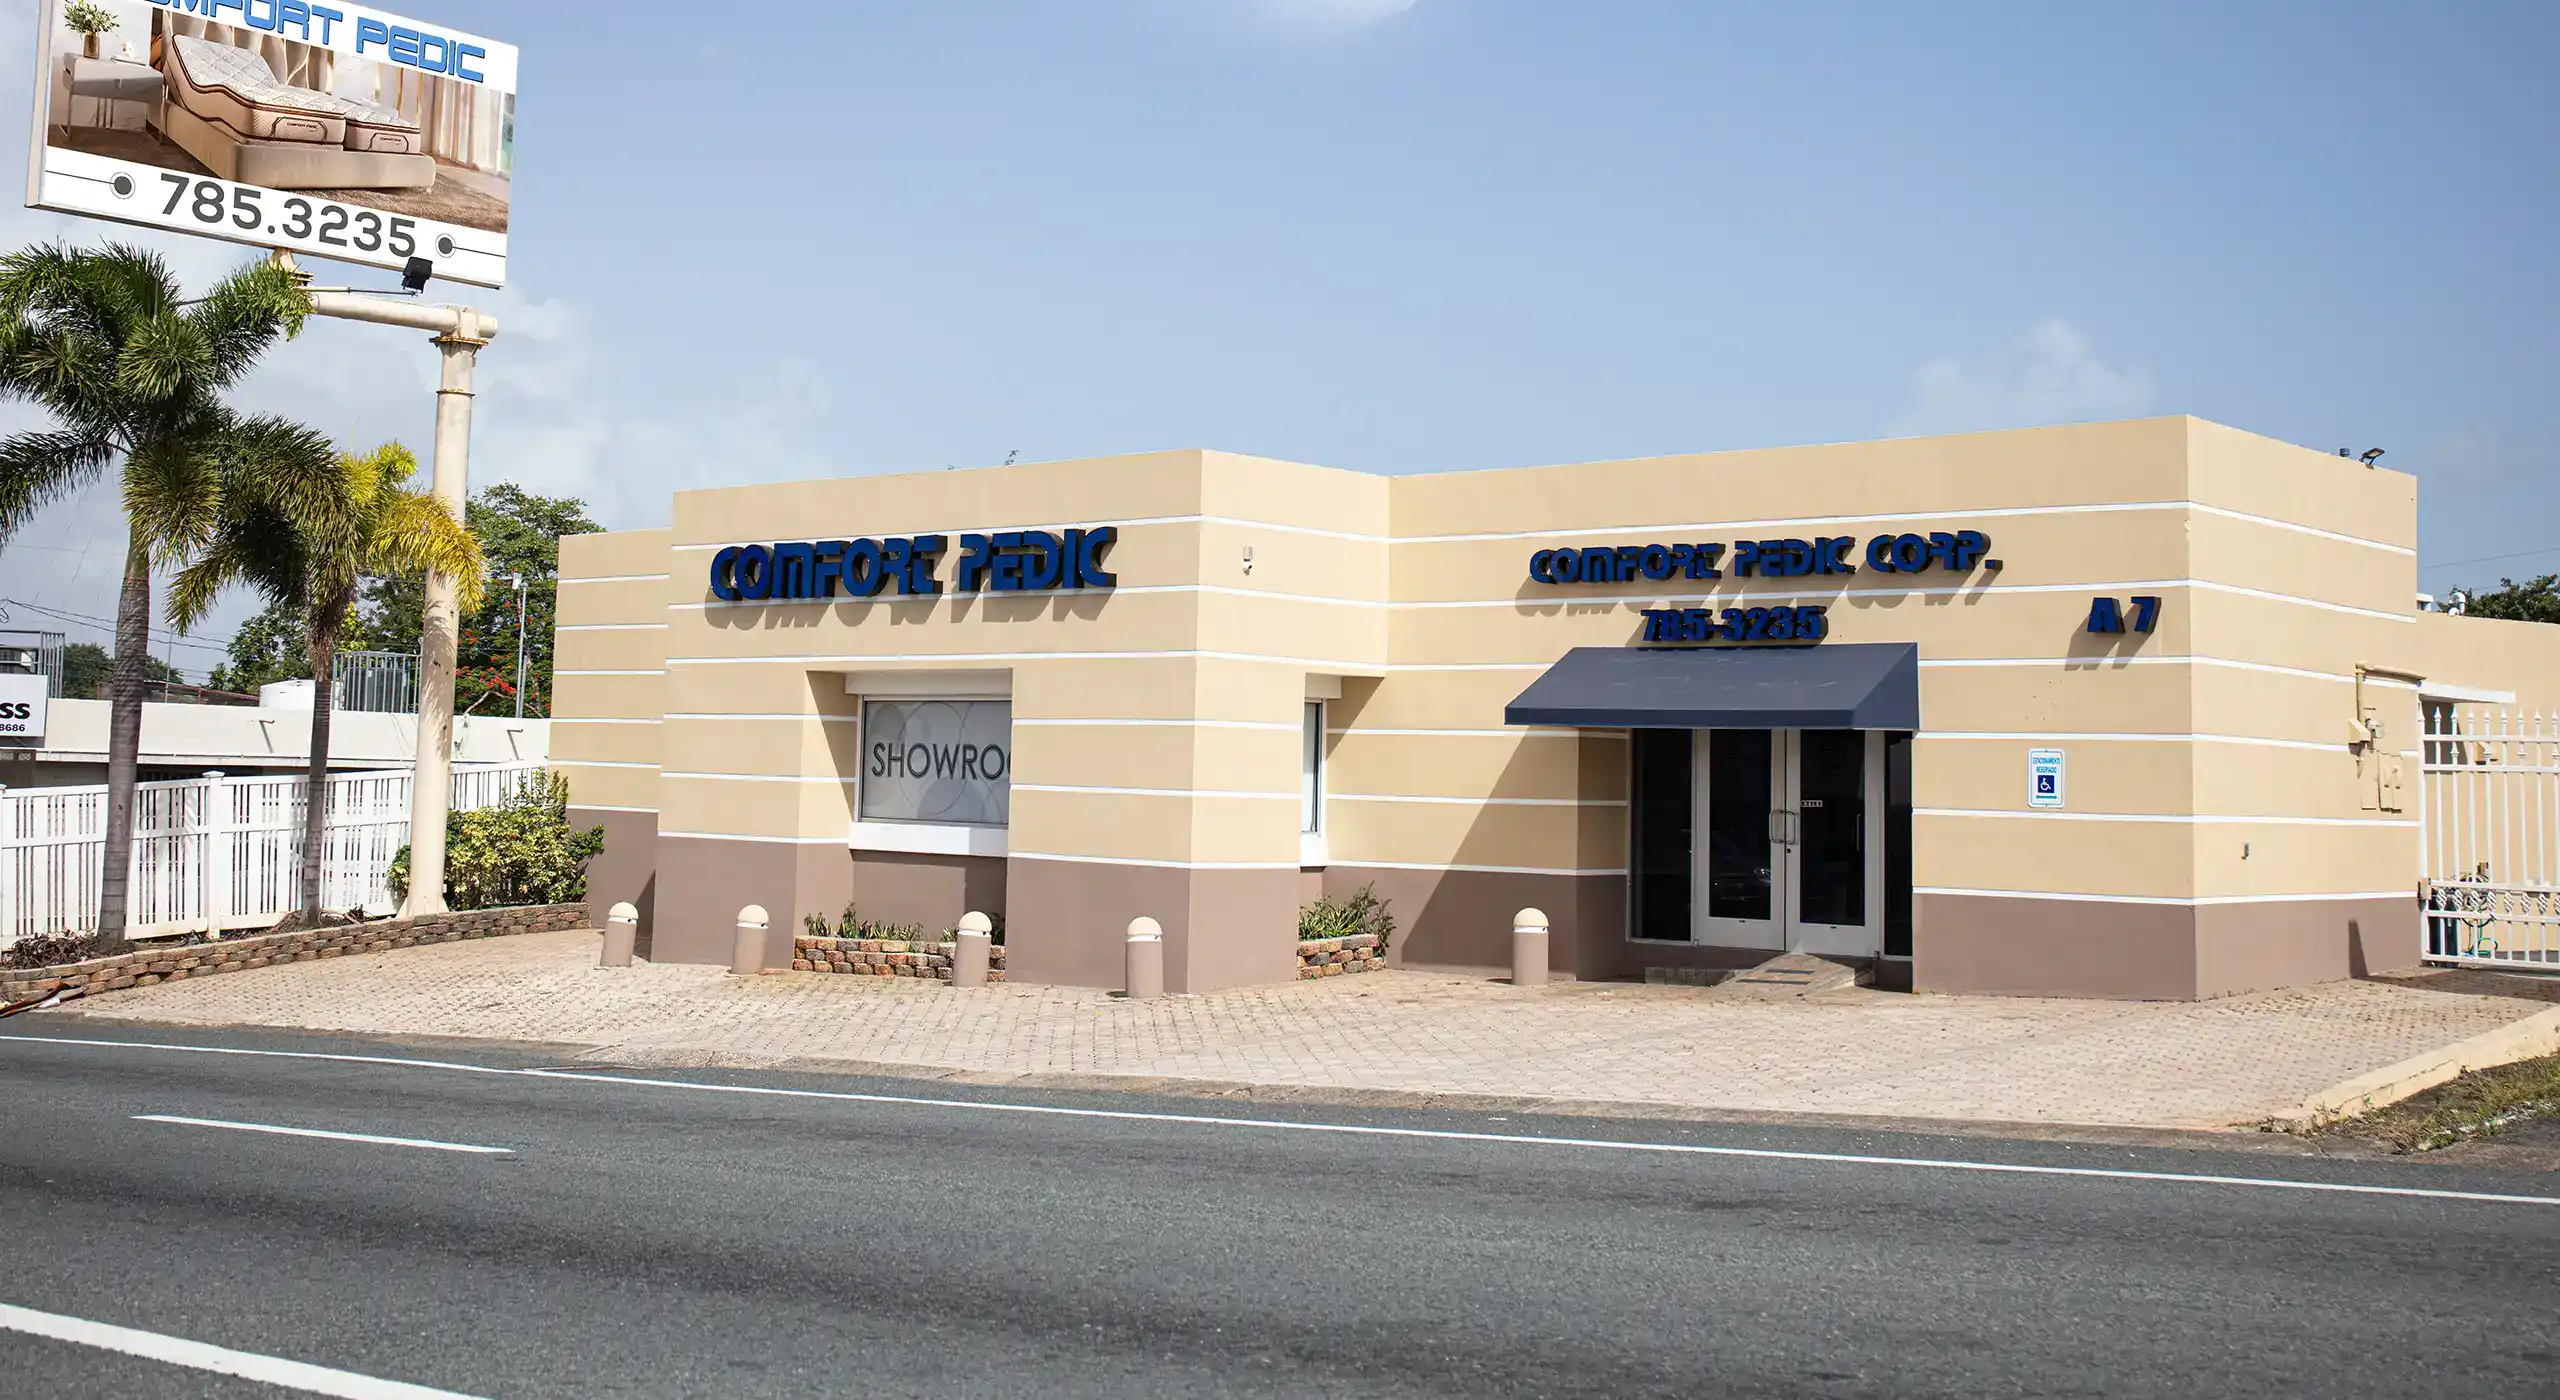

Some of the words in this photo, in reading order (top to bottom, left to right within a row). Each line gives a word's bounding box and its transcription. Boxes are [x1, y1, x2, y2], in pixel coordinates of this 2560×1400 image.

[355, 15, 486, 83] PEDIC
[160, 172, 416, 258] 785.3235
[710, 534, 948, 602] COMFORT
[958, 525, 1118, 592] PEDIC
[1529, 542, 1726, 585] COMFORT
[1733, 535, 1857, 577] PEDIC
[1865, 529, 2004, 573] CORP.
[1640, 605, 1829, 642] 785-3235
[871, 741, 1011, 781] SHOWRO
